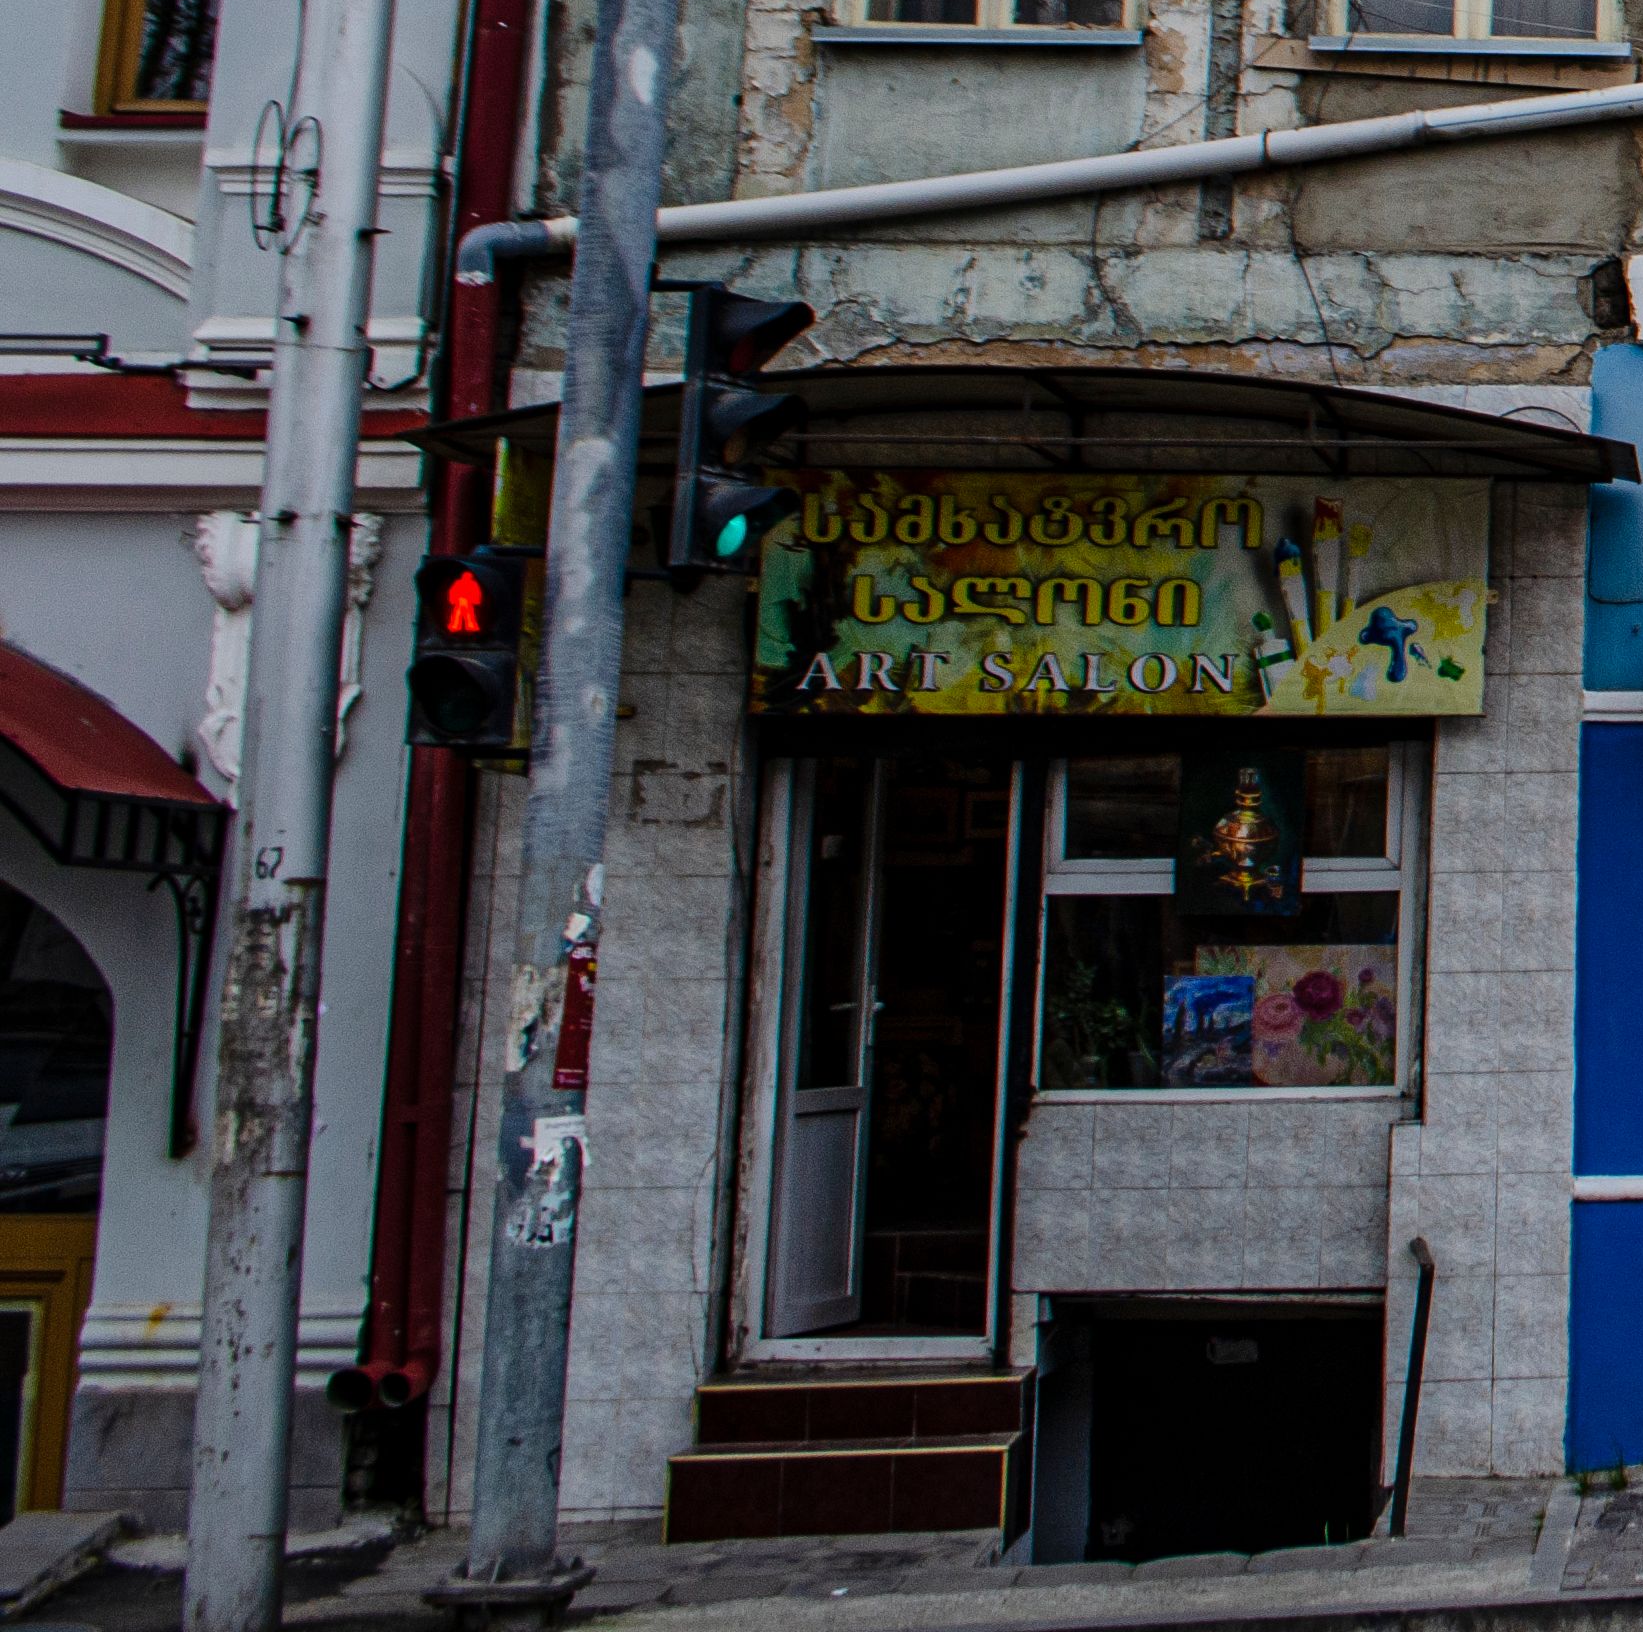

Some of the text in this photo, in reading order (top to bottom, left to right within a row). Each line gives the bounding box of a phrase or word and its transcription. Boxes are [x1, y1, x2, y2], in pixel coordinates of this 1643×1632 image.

[802, 492, 1264, 549] სამხატვრო
[852, 574, 1202, 625] სალონი
[796, 651, 1238, 693] ART SALON
[255, 846, 284, 880] 67
